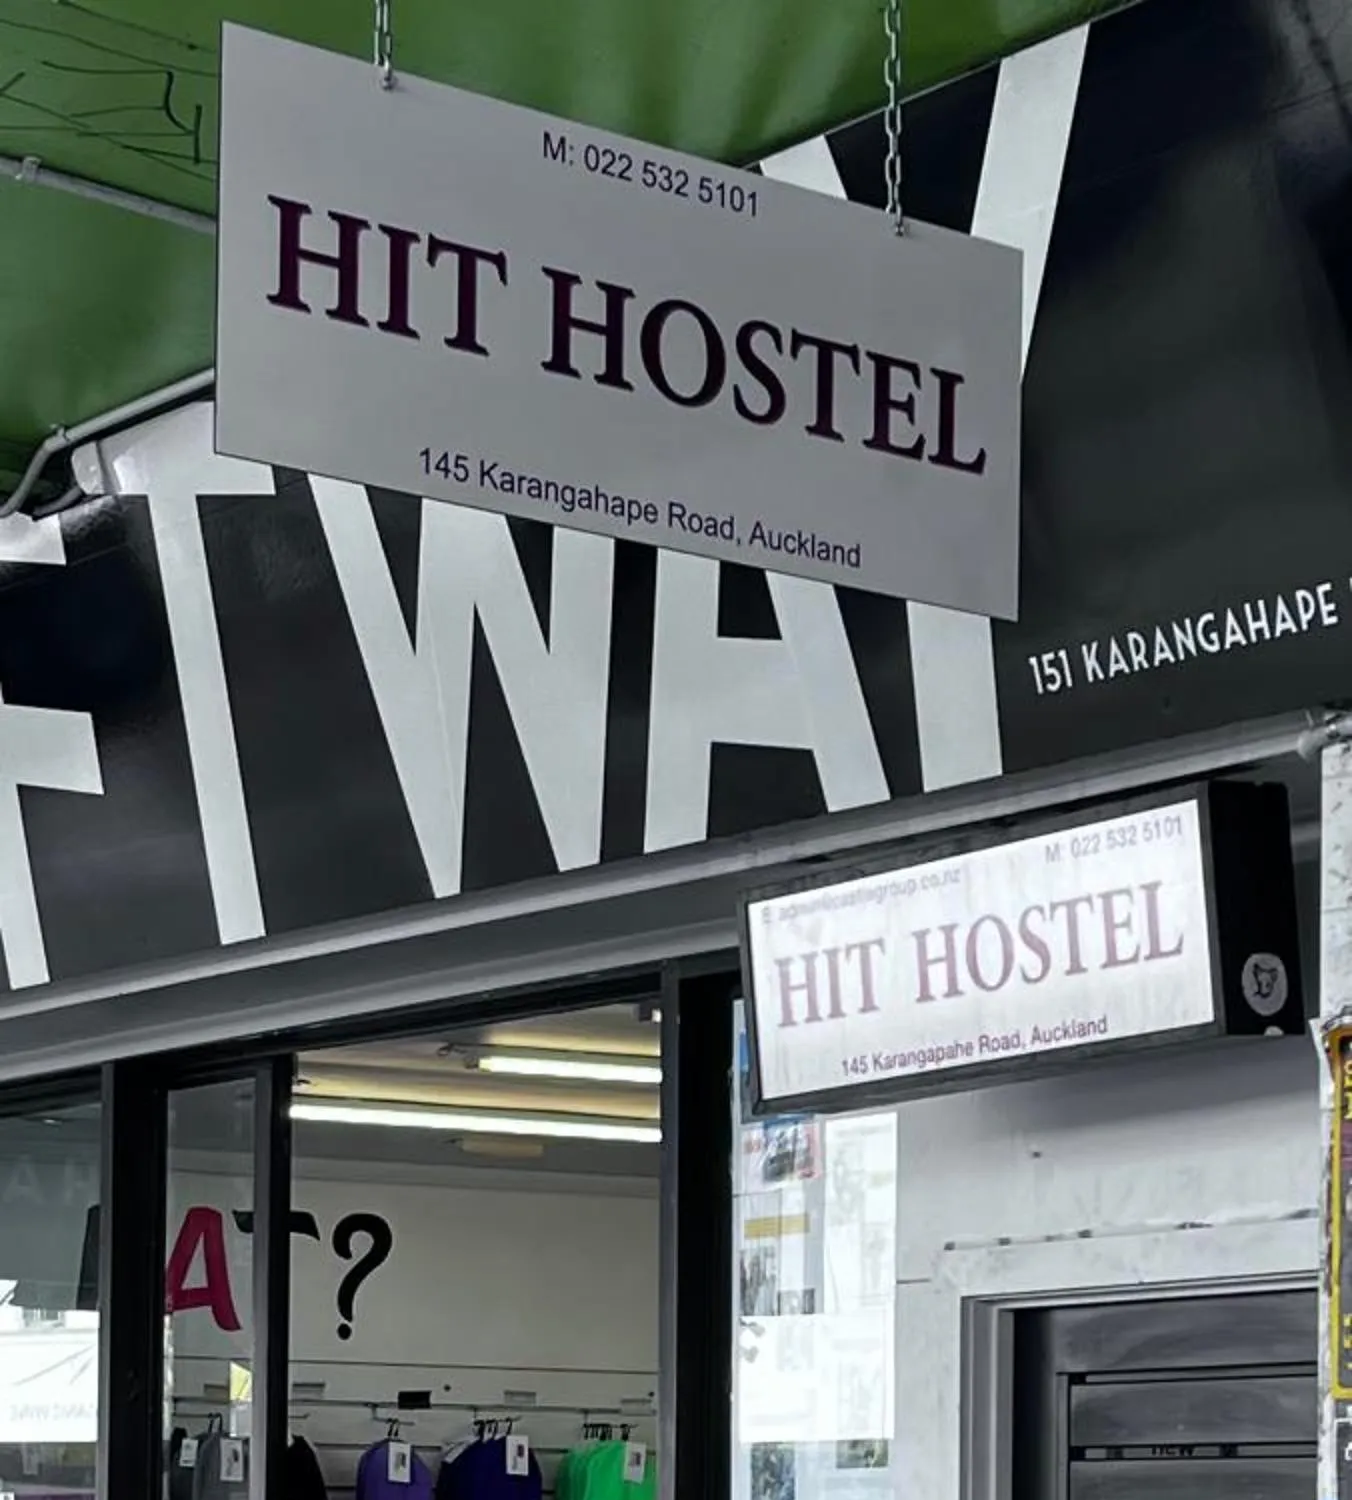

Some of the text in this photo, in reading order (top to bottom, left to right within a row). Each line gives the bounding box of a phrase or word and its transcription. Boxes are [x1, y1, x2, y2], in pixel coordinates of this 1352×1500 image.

[543, 131, 757, 217] M: 022 532 5101
[267, 195, 987, 475] HIT HOSTEL
[419, 447, 861, 569] 145 Karangahape Road, Auckland
[1029, 582, 1339, 694] 151 KARANGAHAPE
[1071, 833, 1100, 858] 022
[1106, 825, 1137, 850] 532
[1143, 814, 1183, 843] 5101
[774, 880, 1184, 1028] HIT HOSTEL
[842, 1053, 869, 1077] 145
[1031, 1014, 1108, 1045] Auckland
